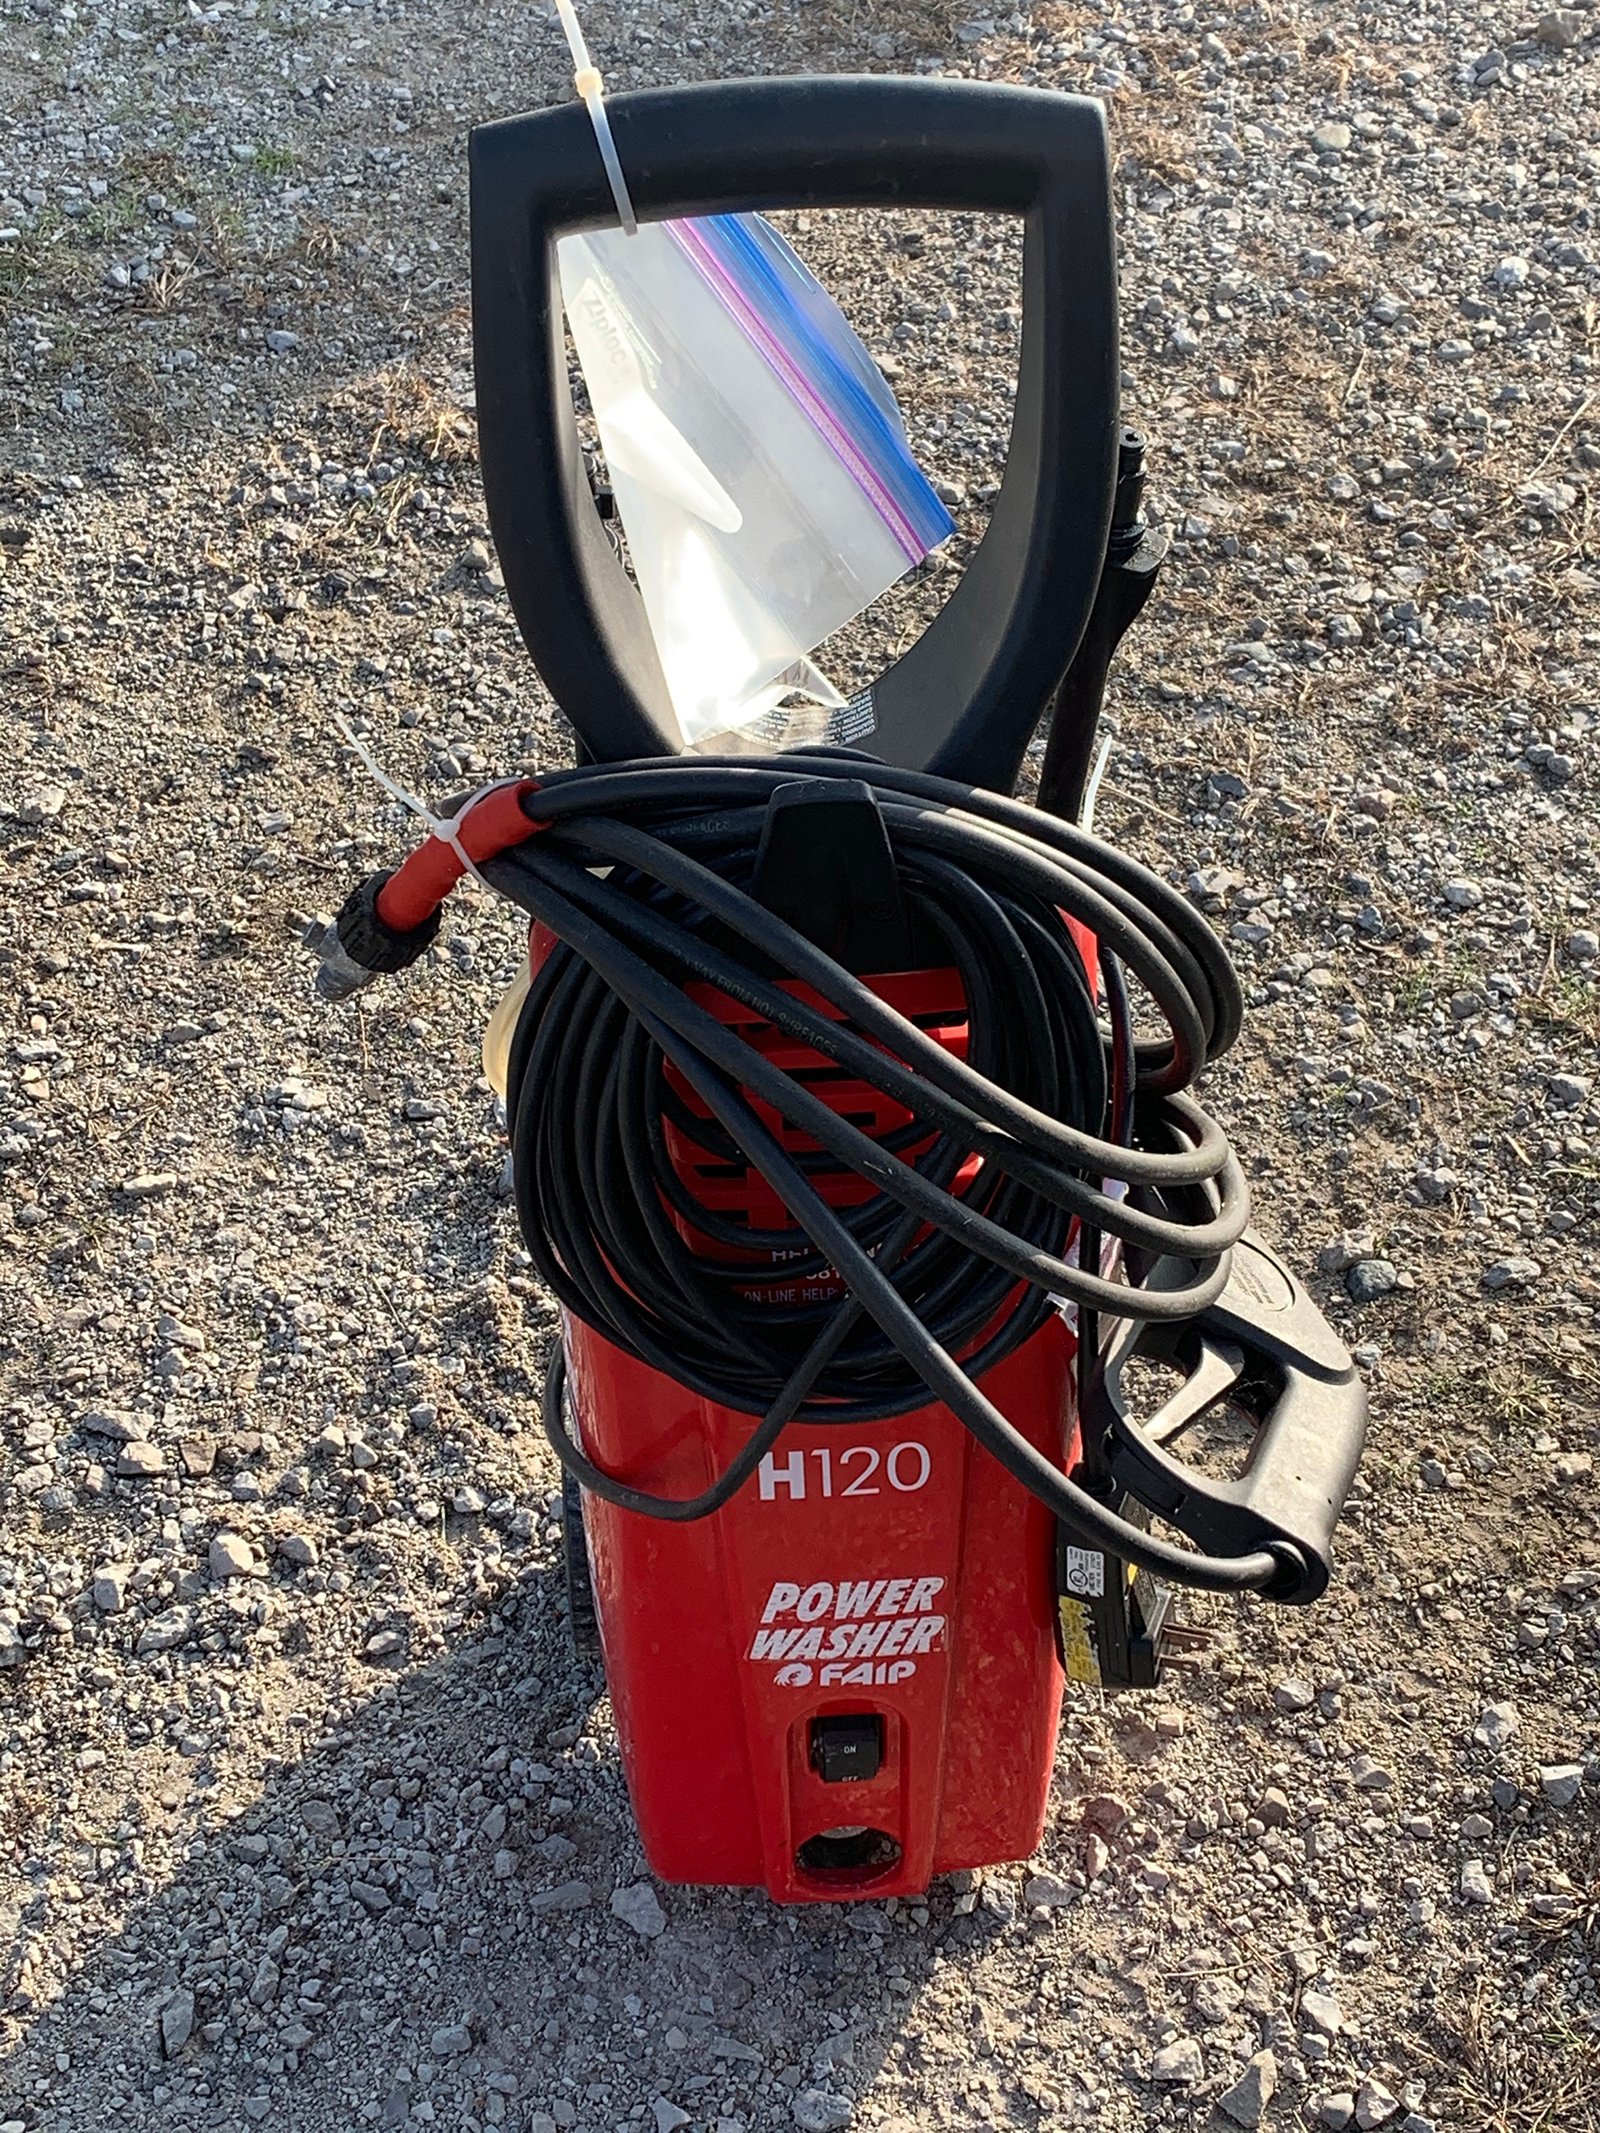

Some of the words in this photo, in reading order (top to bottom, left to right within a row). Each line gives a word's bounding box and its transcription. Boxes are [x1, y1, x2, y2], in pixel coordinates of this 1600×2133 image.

[582, 290, 627, 364] Ziploc
[775, 1011, 839, 1056] SURFACES
[758, 1441, 931, 1500] H120
[760, 1577, 944, 1623] POWER
[750, 1616, 945, 1660] WASHER
[819, 1660, 916, 1686] FAIP
[843, 1745, 856, 1753] ON
